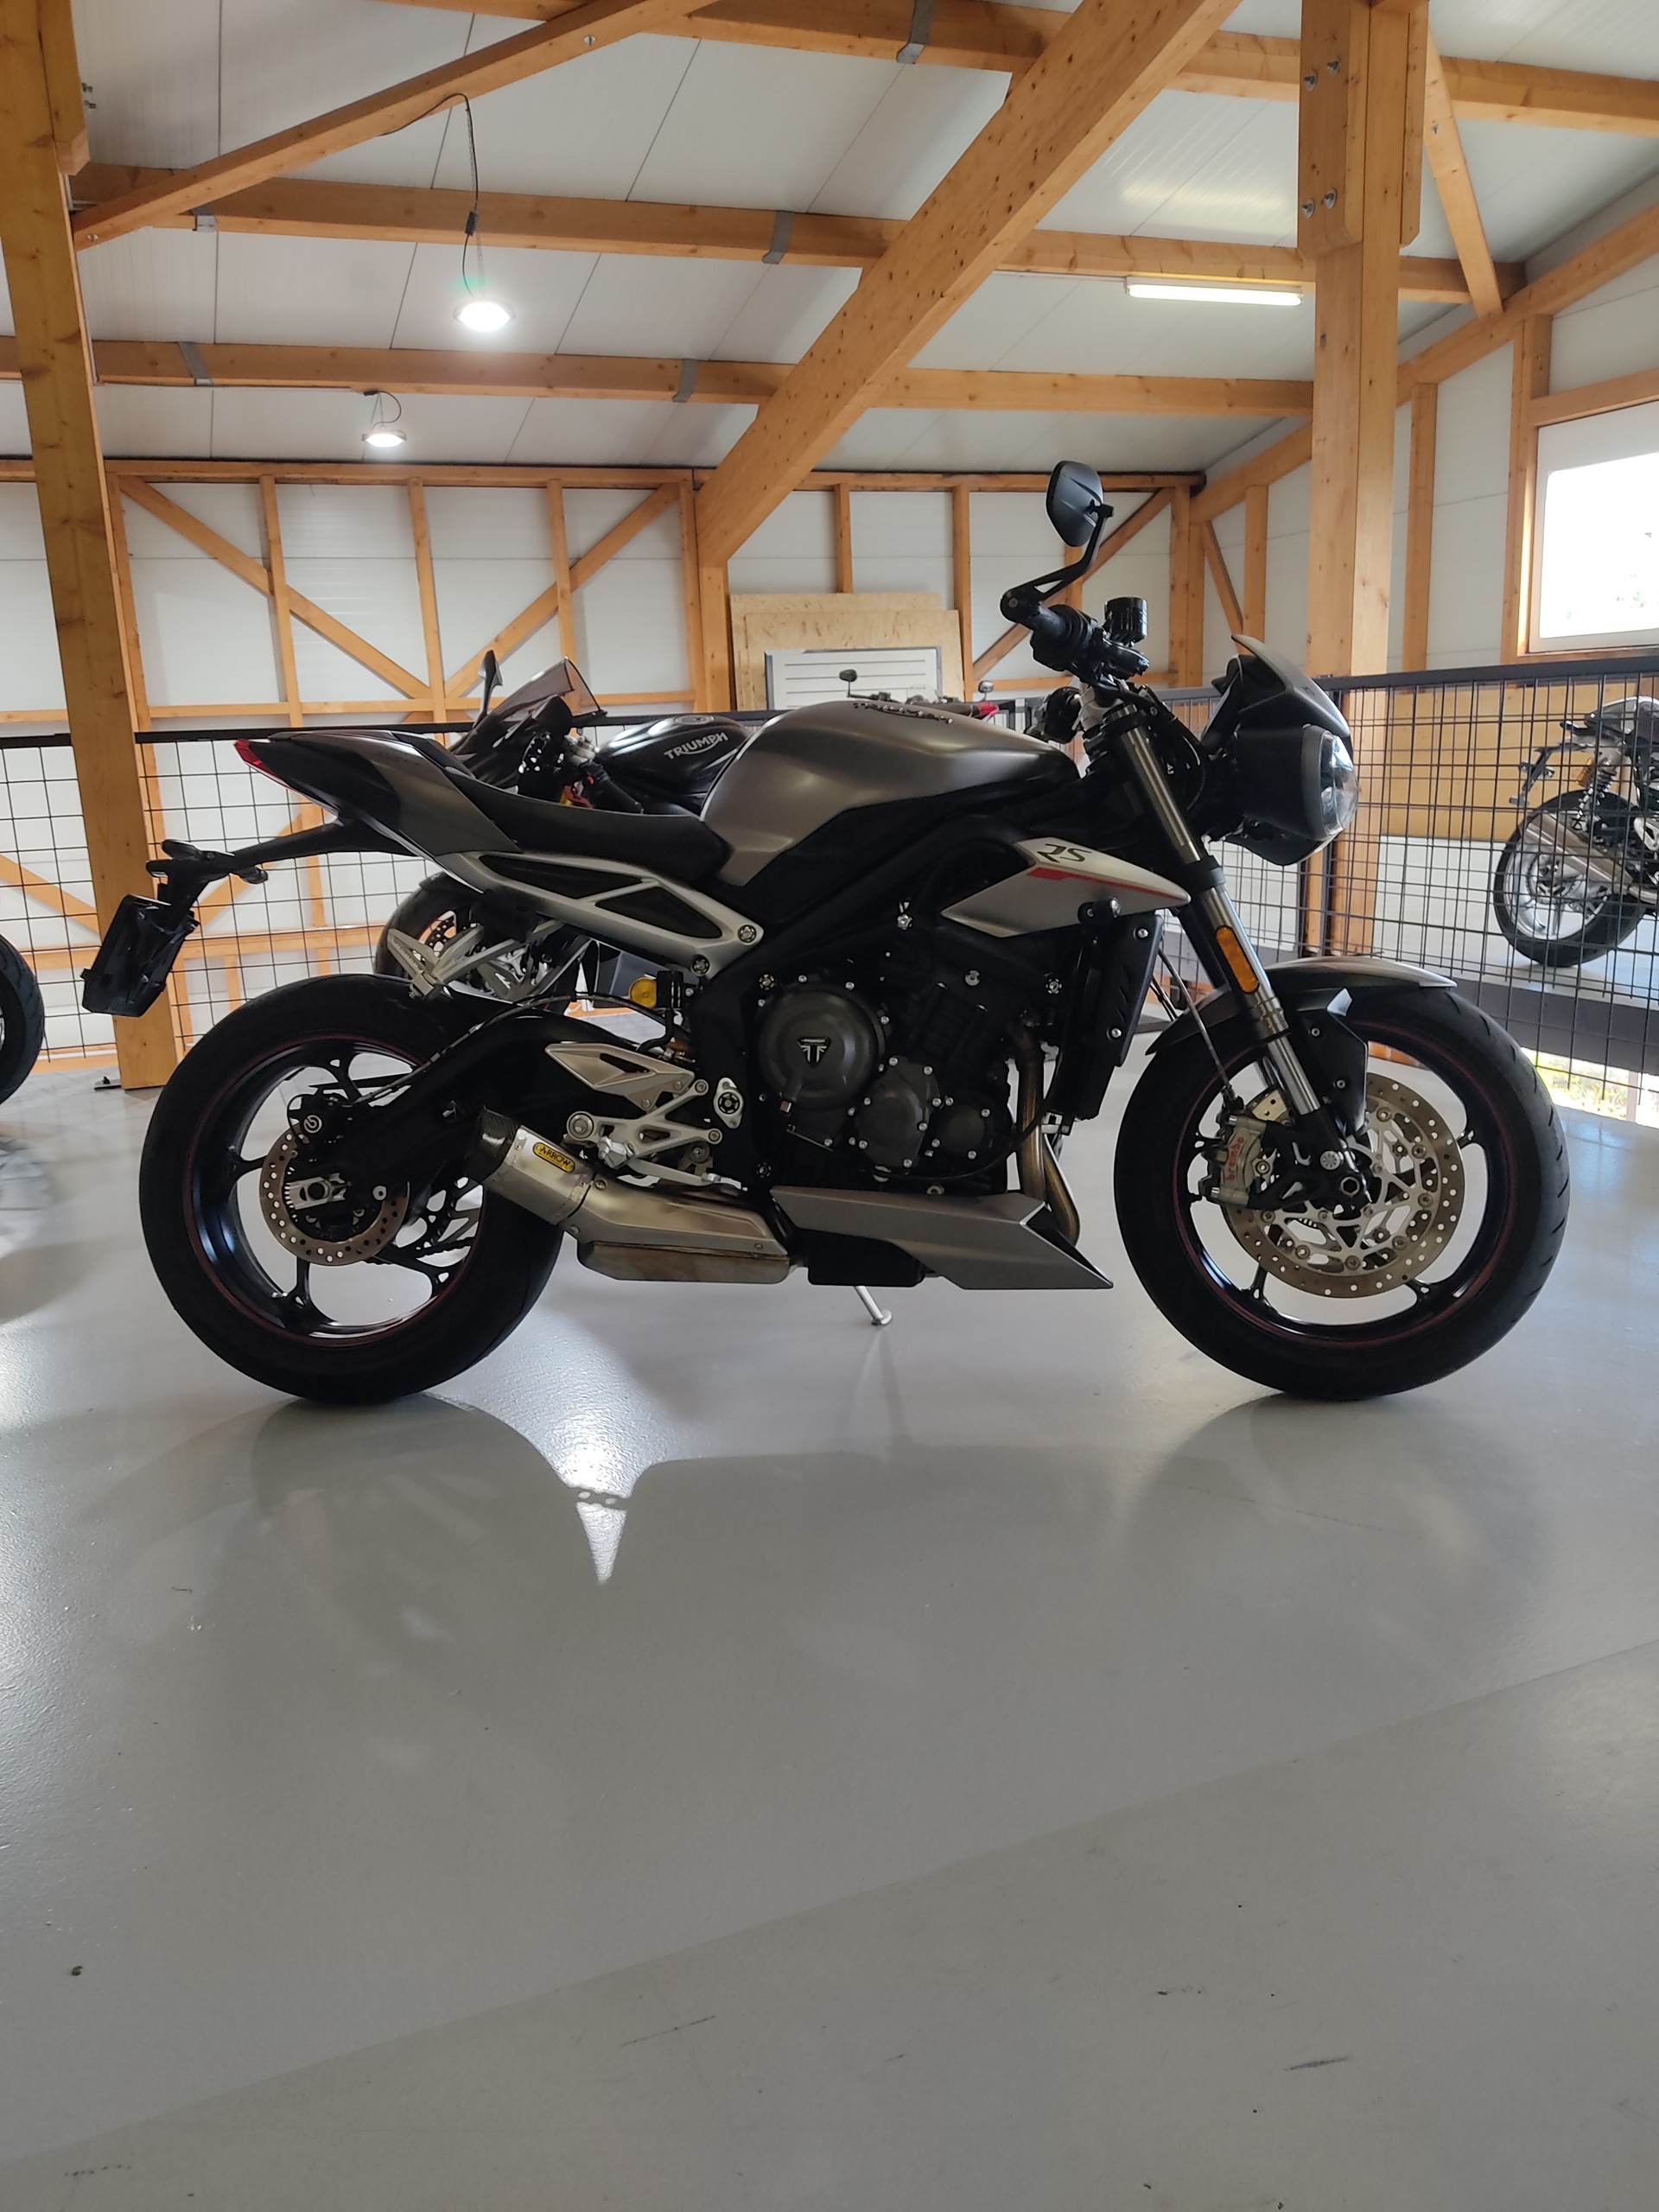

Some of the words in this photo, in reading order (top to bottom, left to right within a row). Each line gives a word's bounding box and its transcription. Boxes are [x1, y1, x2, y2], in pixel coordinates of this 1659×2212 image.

[663, 732, 728, 760] TRIUMPH
[1037, 843, 1092, 863] RS
[539, 1146, 571, 1166] ARROW
[1225, 1136, 1244, 1181] brembo
